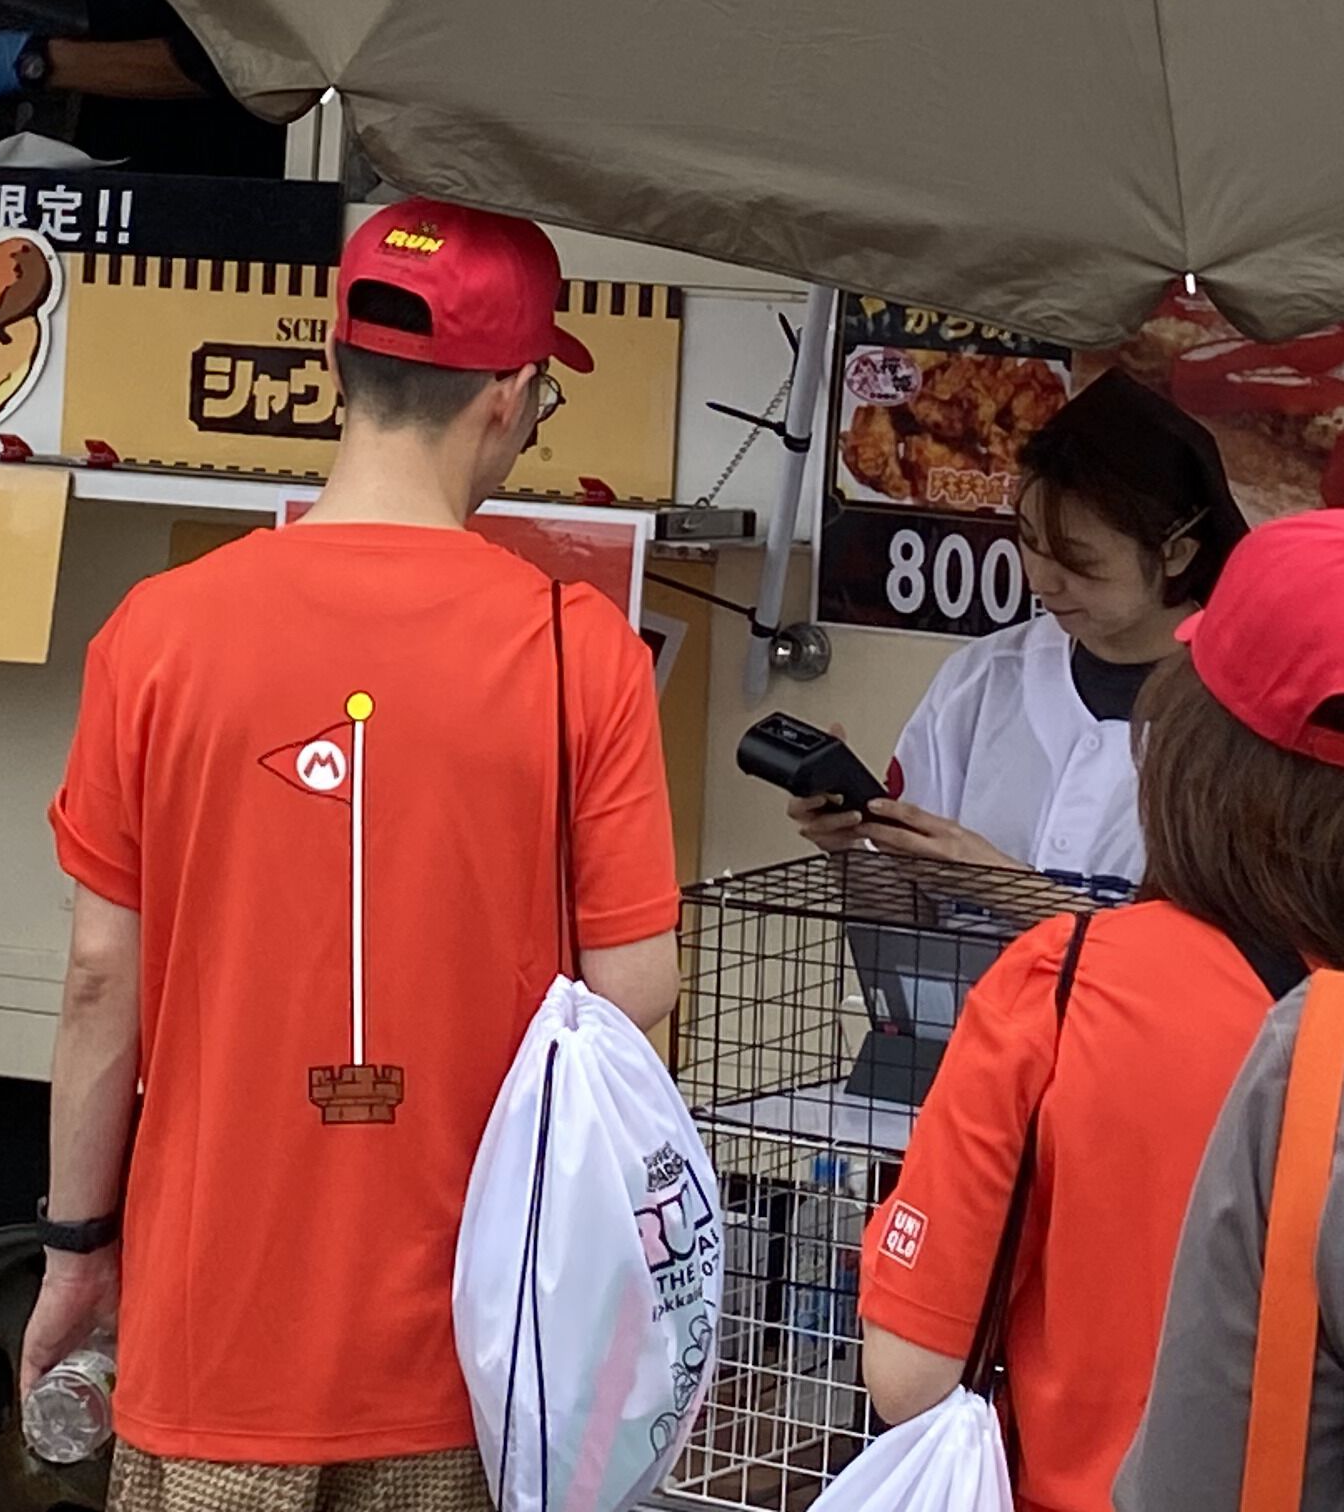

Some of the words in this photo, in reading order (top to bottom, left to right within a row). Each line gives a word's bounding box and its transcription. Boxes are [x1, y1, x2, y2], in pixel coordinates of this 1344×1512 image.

[383, 229, 446, 253] RUN
[276, 316, 328, 343] SCH
[202, 355, 346, 426] シャウ
[886, 528, 1023, 624] 800
[656, 1262, 696, 1295] THE
